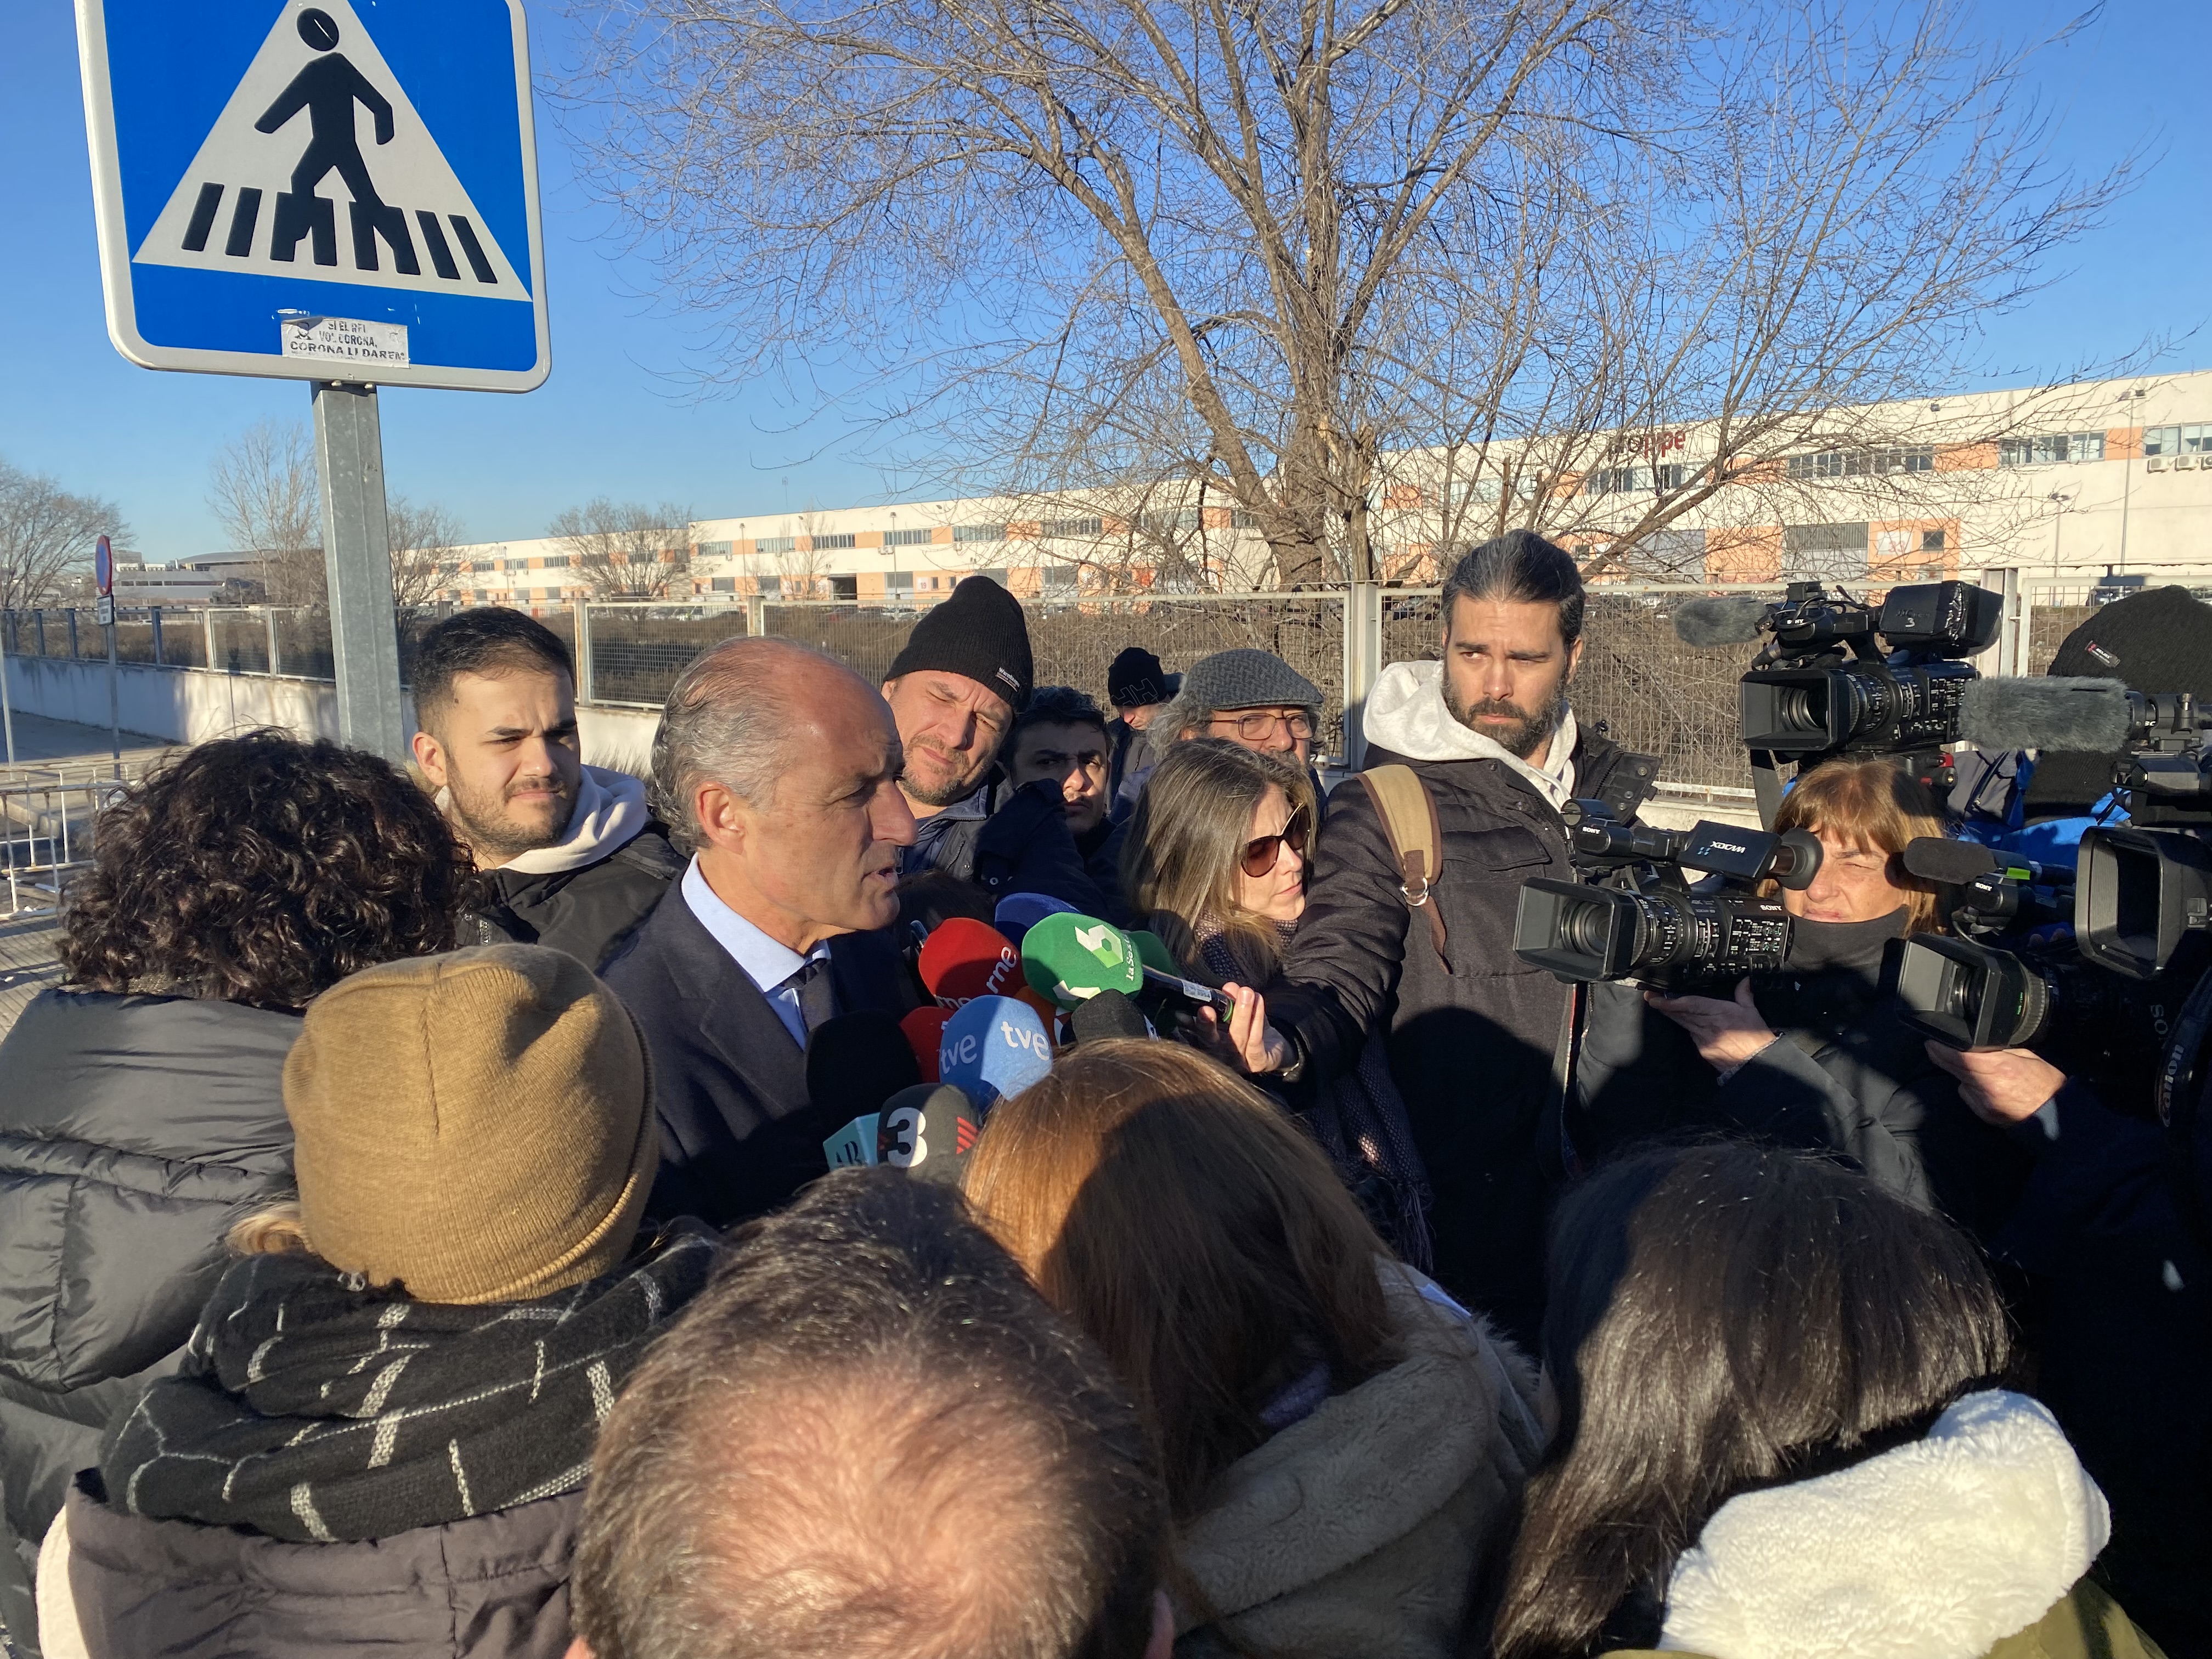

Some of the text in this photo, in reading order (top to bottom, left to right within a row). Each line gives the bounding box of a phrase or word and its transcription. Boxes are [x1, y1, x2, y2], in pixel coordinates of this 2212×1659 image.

[290, 341, 344, 354] CORONA
[1905, 617, 1915, 628] 3
[1582, 826, 1601, 834] SONY
[1709, 840, 1746, 854] XDCAM
[1974, 882, 1993, 891] SONY
[986, 946, 1018, 994] rne
[1001, 1021, 1050, 1061] tve
[940, 1035, 977, 1074] tve
[887, 1107, 928, 1169] 3
